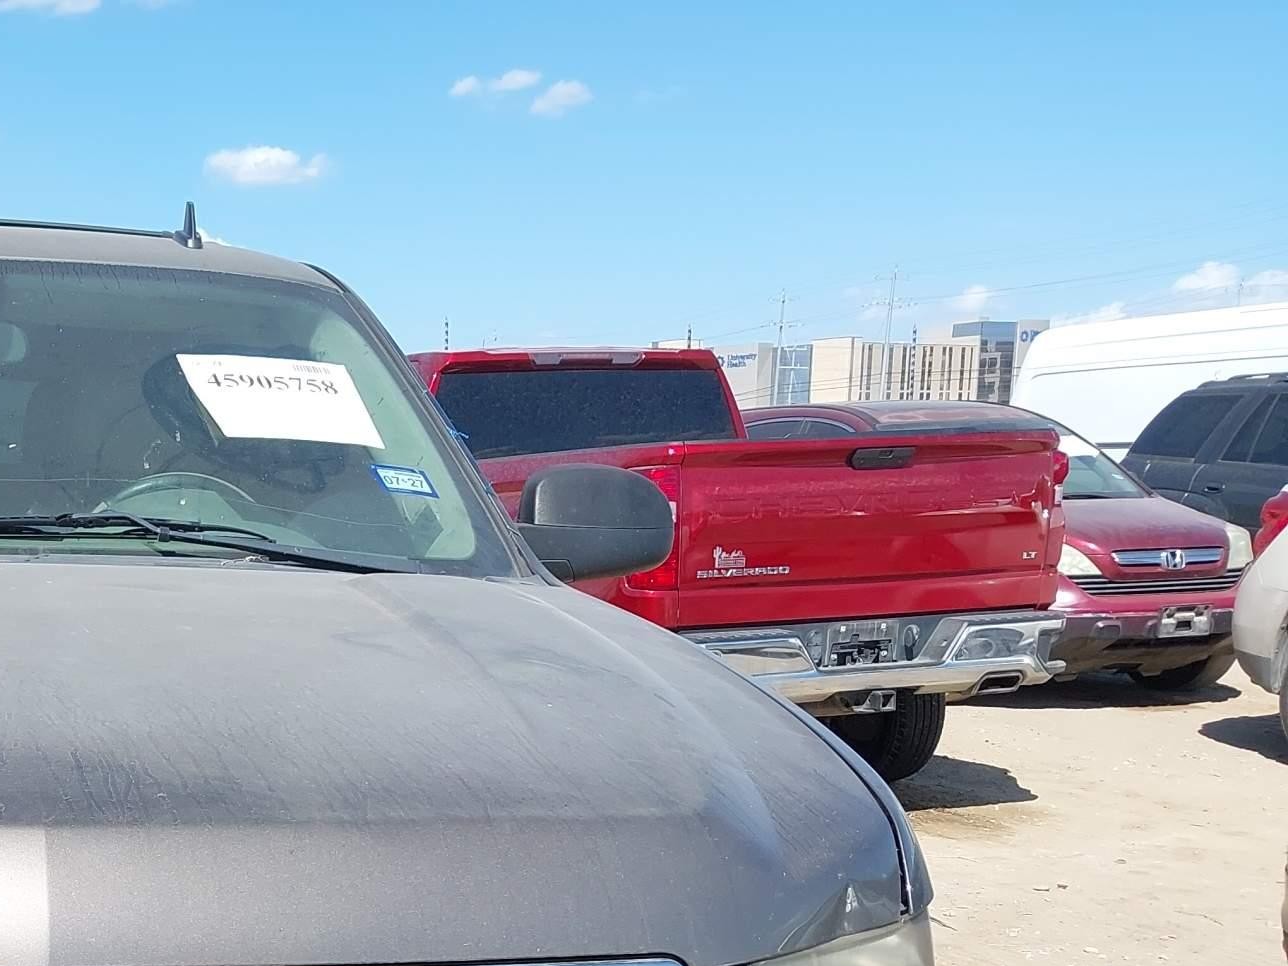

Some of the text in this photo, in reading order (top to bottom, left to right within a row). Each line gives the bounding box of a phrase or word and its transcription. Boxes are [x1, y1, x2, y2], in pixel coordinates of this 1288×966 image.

[207, 373, 339, 395] 45905758
[1022, 551, 1038, 559] LT
[696, 566, 791, 579] SILVERADO
